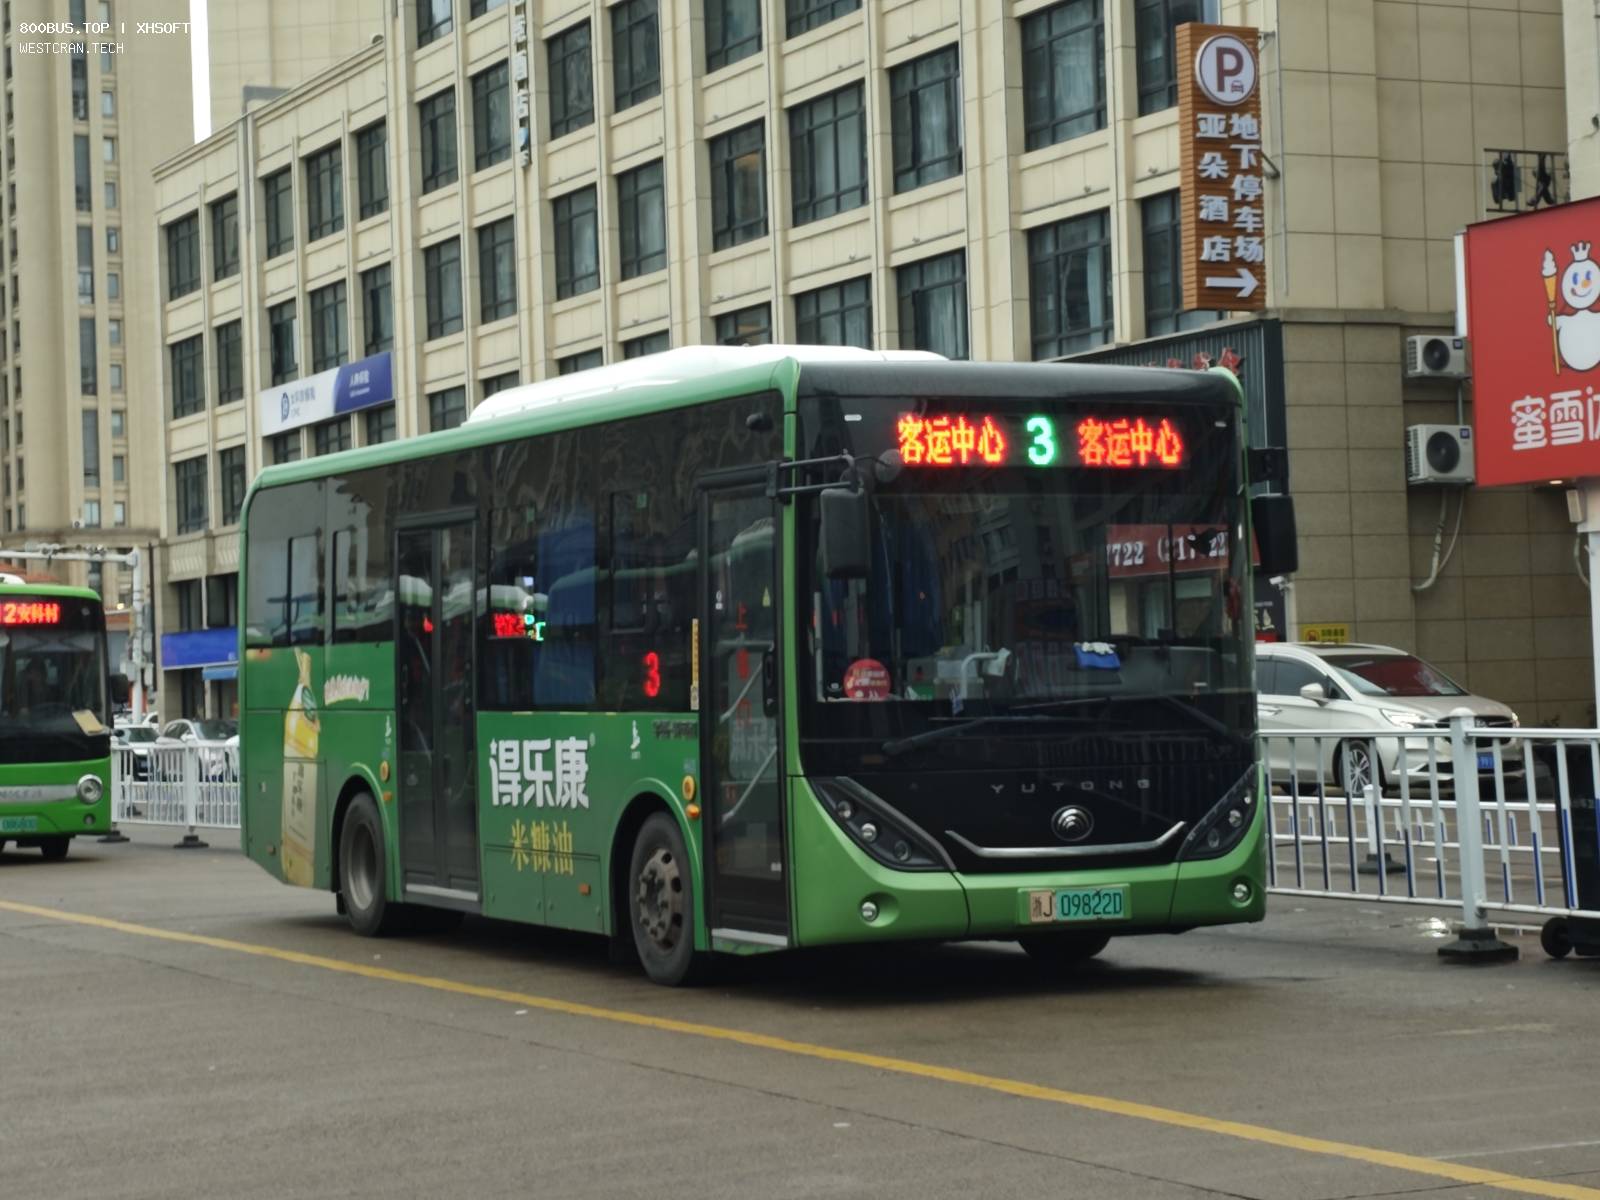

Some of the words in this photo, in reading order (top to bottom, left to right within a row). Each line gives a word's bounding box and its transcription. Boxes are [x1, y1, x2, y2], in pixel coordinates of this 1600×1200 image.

[1216, 46, 1244, 92] P
[1196, 112, 1232, 262] 亚朵酒店
[1229, 112, 1264, 262] 地下停车场
[897, 413, 1006, 465] 客运中心
[1026, 415, 1056, 466] 3
[1078, 416, 1183, 467] 客运中心
[1106, 541, 1144, 567] 722
[643, 652, 660, 697] 3
[489, 736, 590, 809] 得乐康
[990, 778, 1150, 794] YUTONG
[509, 818, 574, 876] 米糠油
